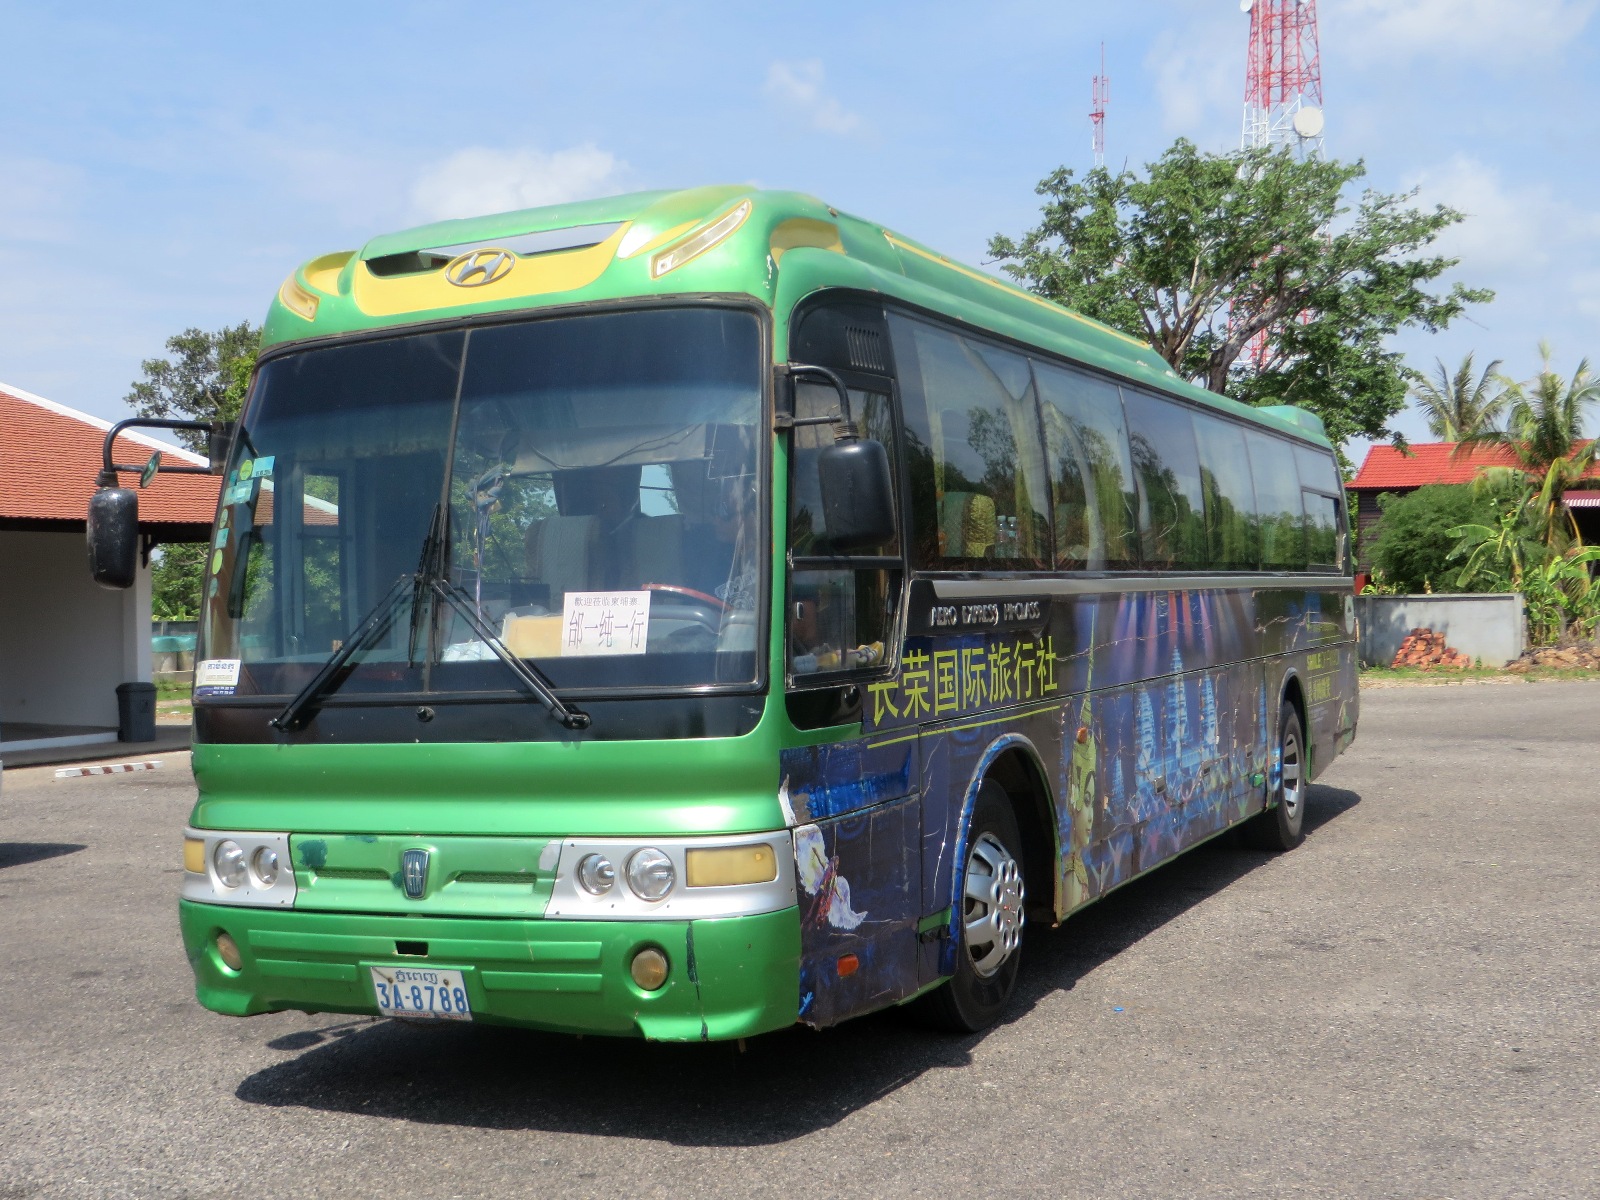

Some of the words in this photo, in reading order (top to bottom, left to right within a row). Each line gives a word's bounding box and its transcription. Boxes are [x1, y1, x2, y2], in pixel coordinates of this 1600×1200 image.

[930, 606, 957, 626] AERO
[961, 603, 999, 626] EXPRESS
[867, 636, 1058, 727] 长荣国际旅行社
[376, 982, 468, 1015] 3A-8788
